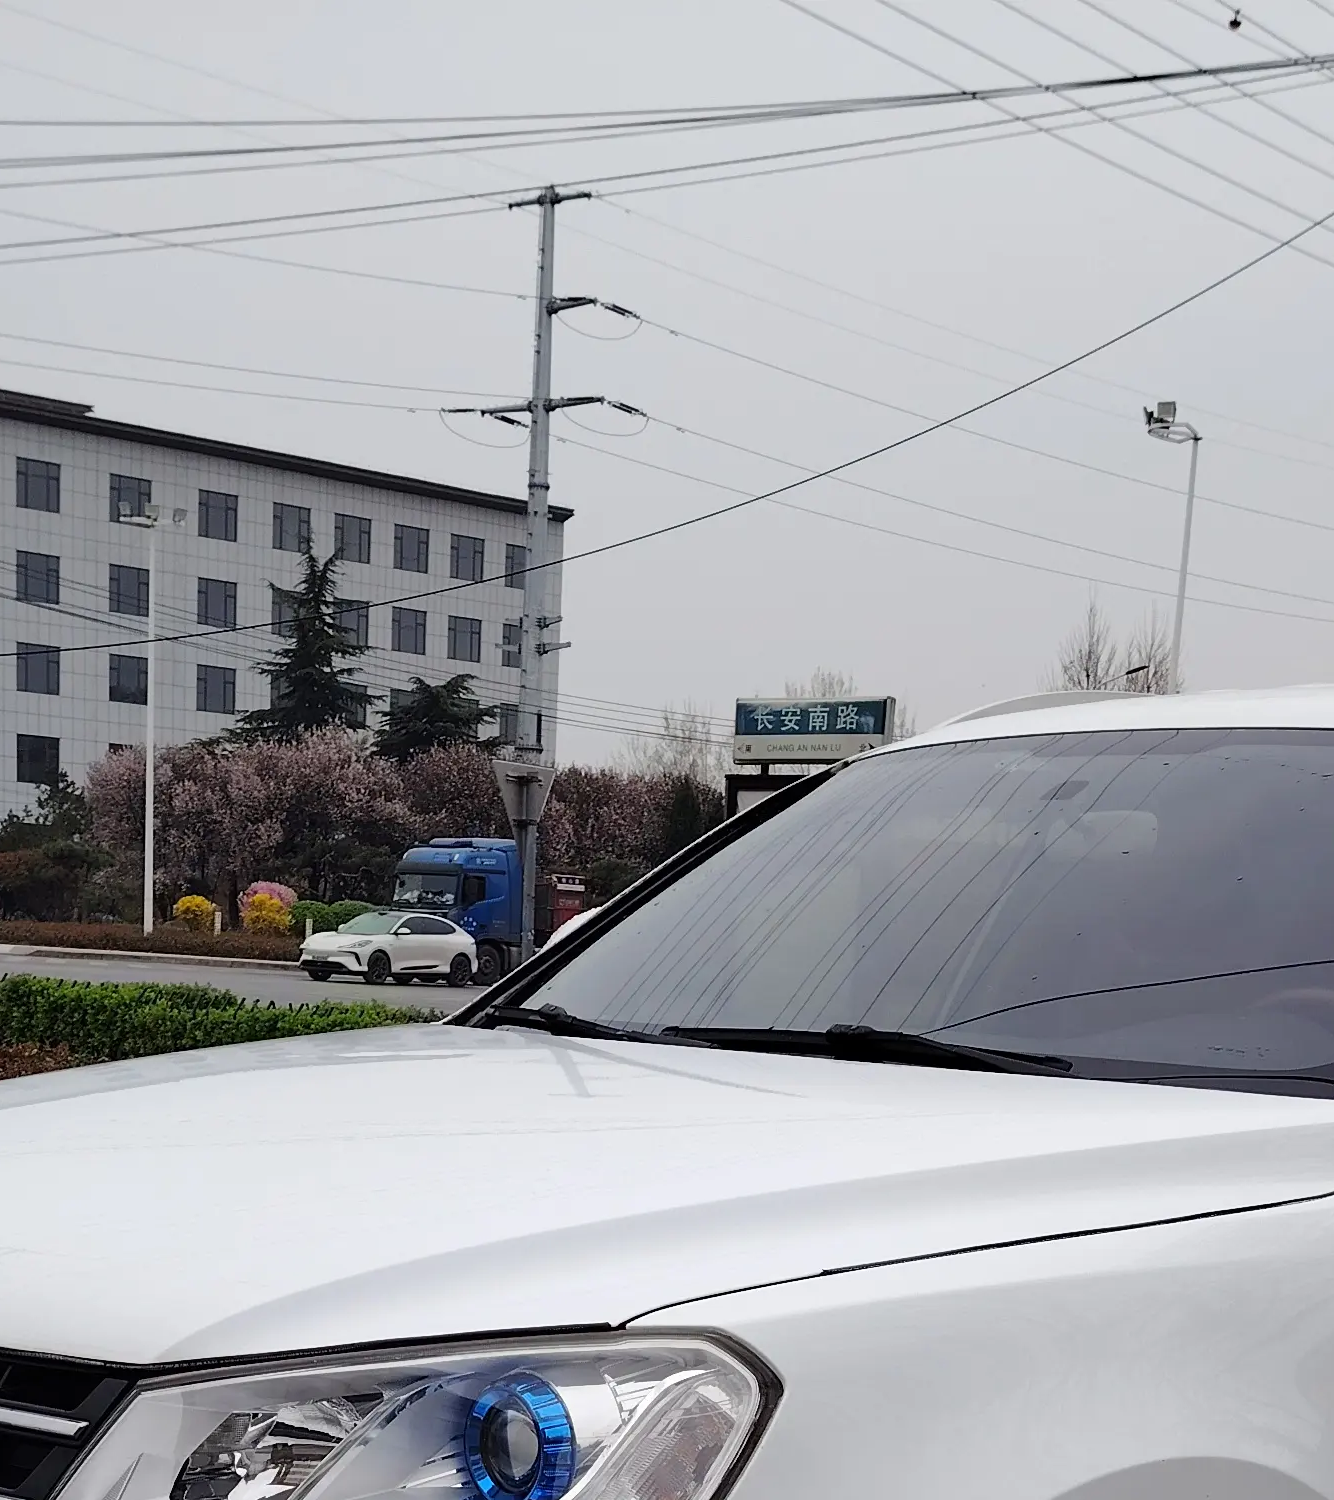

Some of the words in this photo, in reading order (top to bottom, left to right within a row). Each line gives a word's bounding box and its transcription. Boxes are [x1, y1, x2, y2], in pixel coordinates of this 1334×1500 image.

[754, 704, 859, 731] 长安南路
[767, 743, 795, 752] CHANG
[797, 743, 808, 752] AN
[810, 743, 828, 752] NAN
[830, 743, 842, 752] LU
